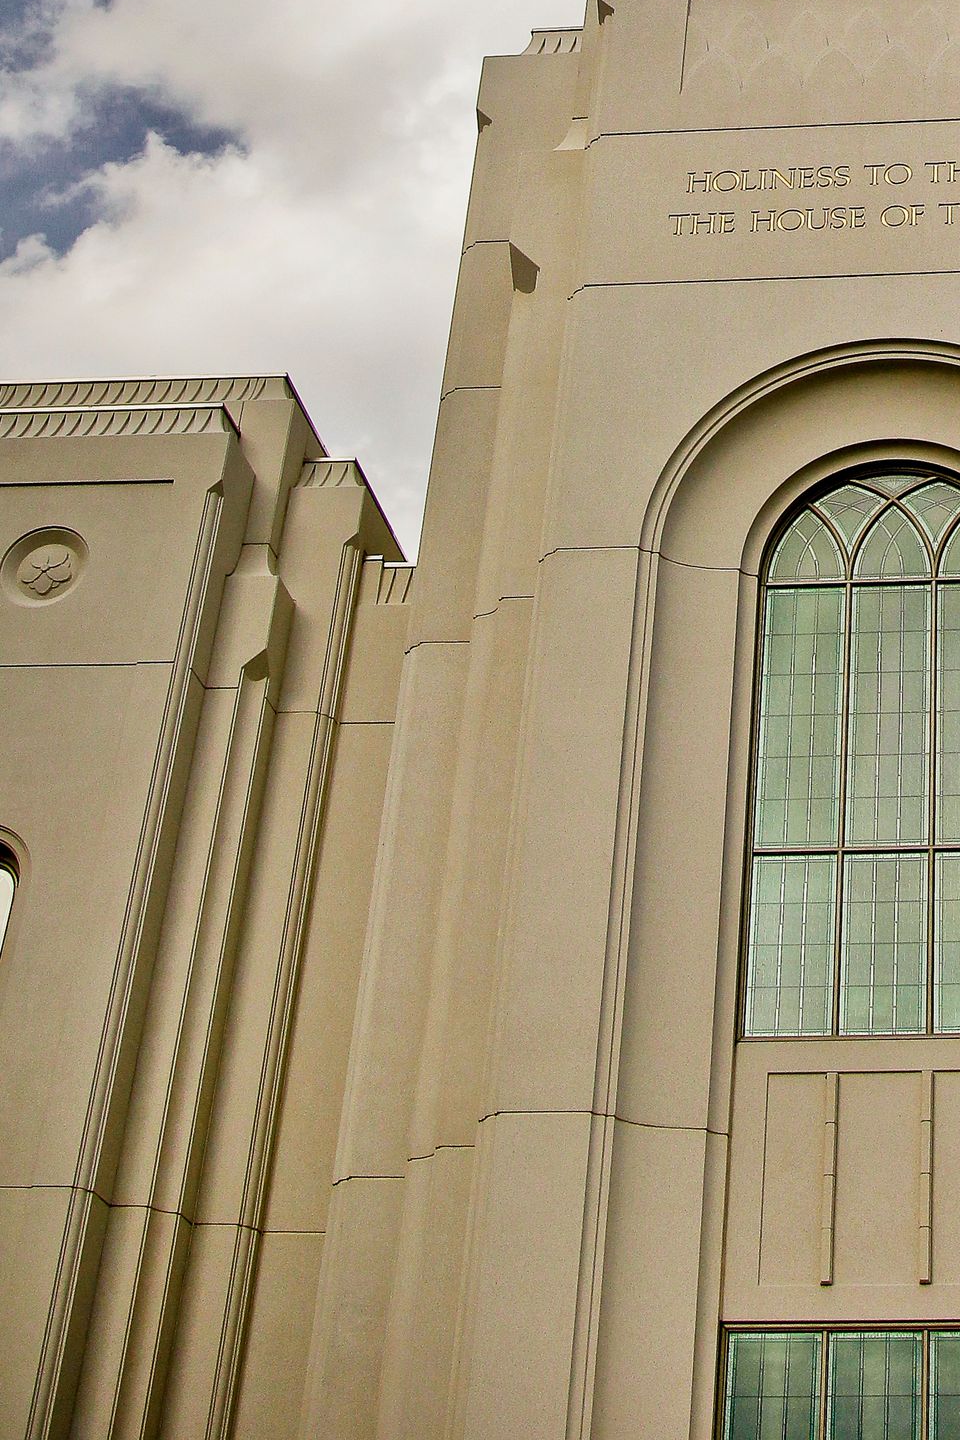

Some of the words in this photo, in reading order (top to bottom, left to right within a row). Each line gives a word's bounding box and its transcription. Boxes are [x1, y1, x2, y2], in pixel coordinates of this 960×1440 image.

[685, 165, 851, 193] HOLINESS
[864, 162, 913, 187] TO
[668, 212, 736, 236] THE
[749, 207, 867, 233] HOUSE
[879, 204, 926, 228] OF
